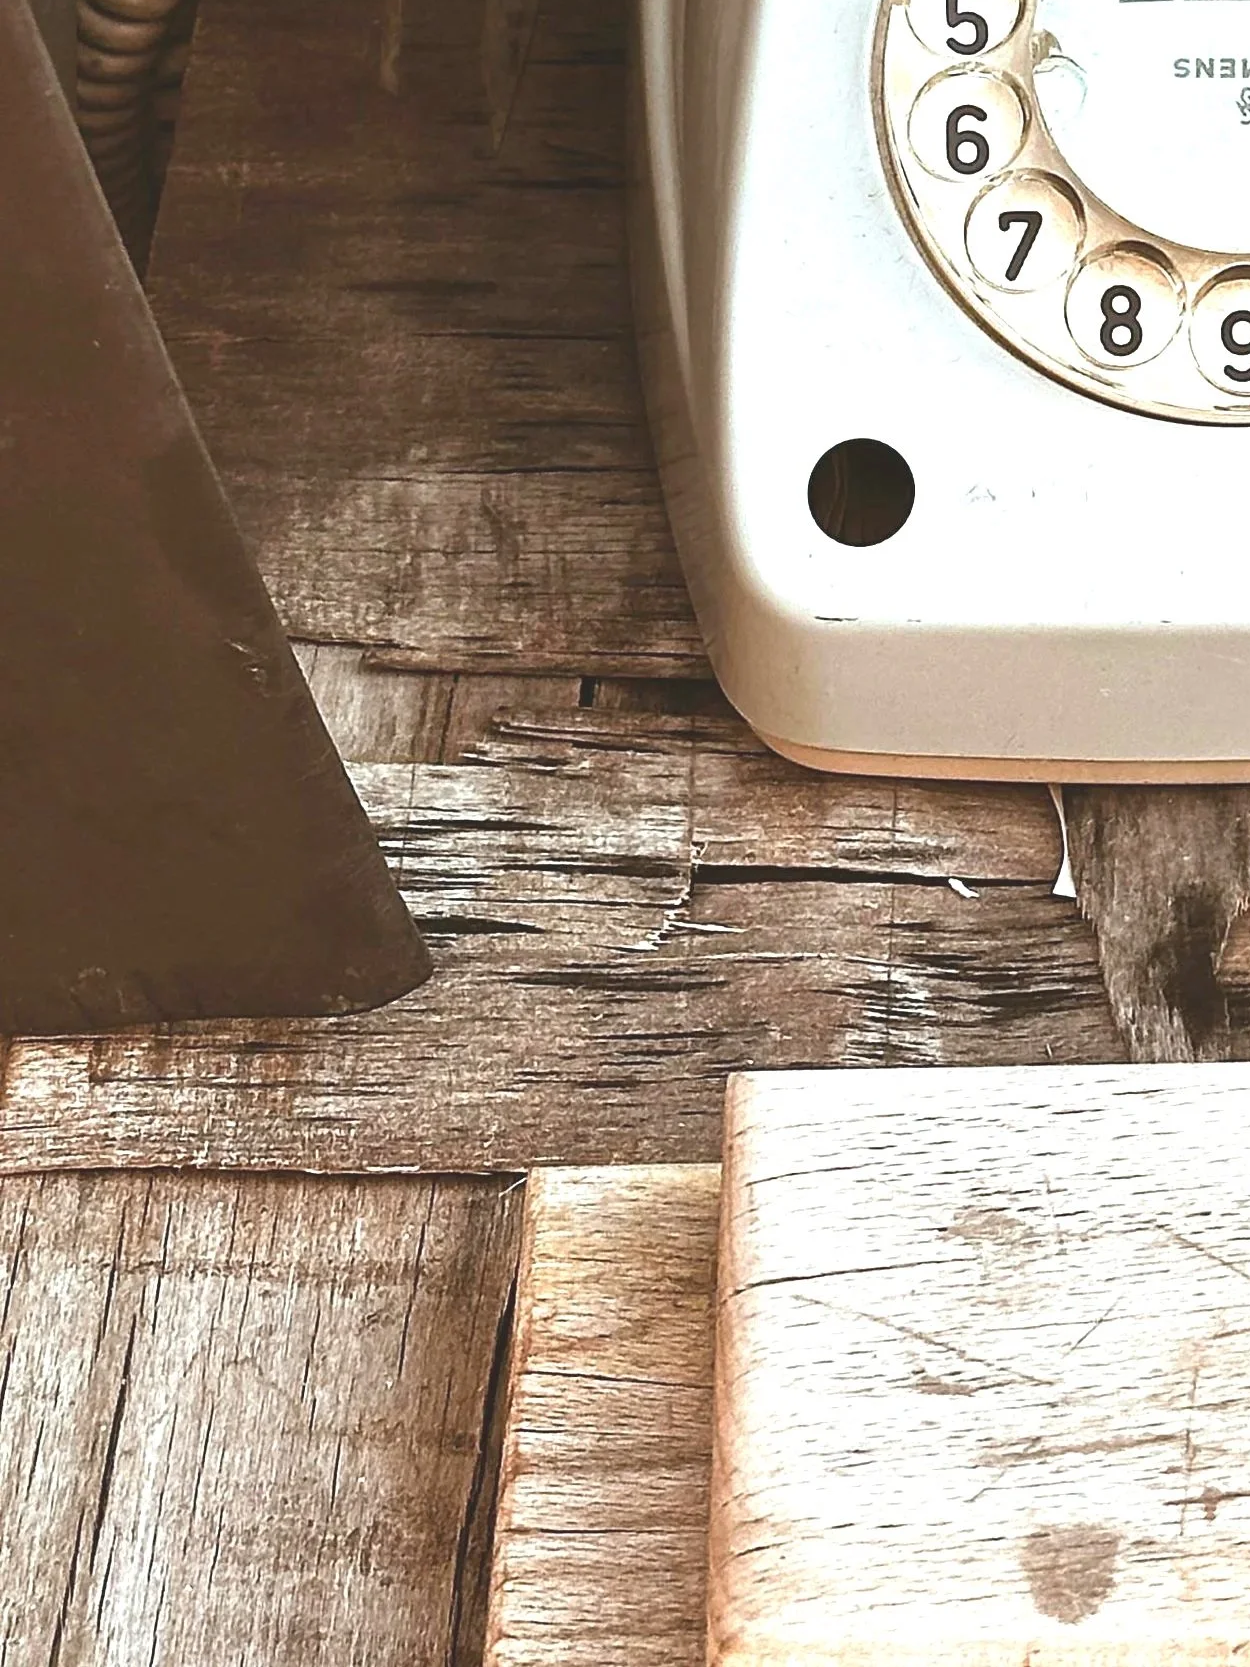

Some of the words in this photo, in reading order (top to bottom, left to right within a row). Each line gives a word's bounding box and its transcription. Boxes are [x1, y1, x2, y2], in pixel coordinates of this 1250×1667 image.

[946, 105, 989, 174] 6
[999, 211, 1042, 281] 7
[1100, 285, 1142, 356] 8
